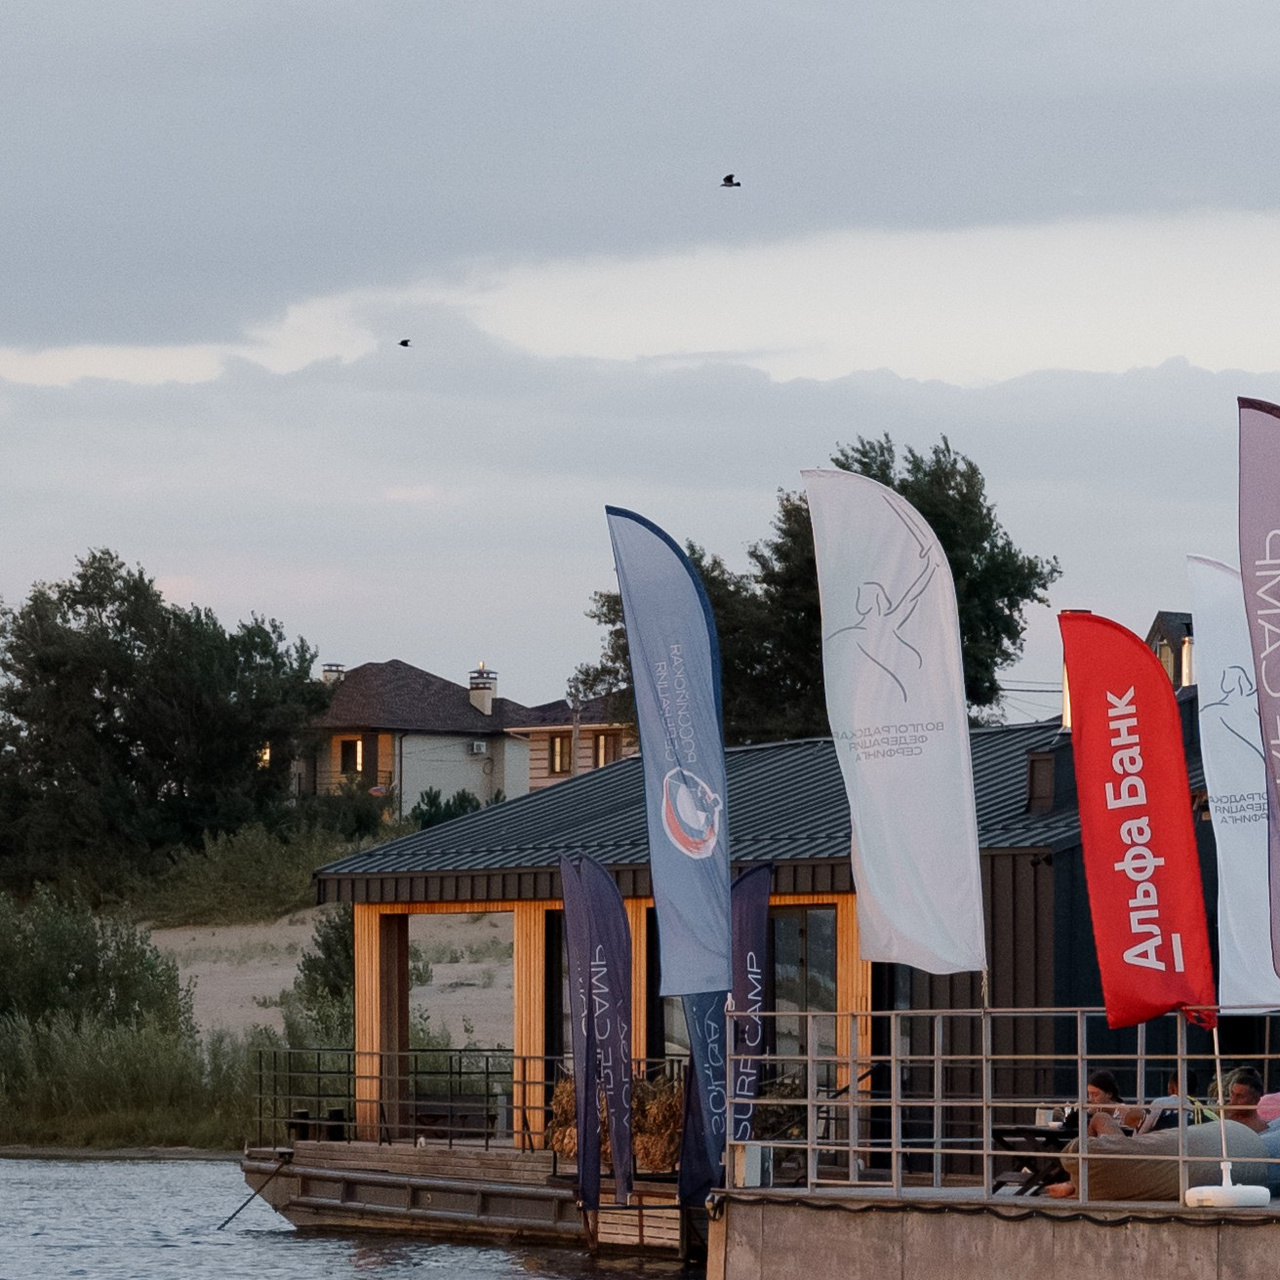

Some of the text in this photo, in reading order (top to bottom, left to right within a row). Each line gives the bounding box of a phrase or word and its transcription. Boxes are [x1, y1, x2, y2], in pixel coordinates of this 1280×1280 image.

[1104, 685, 1166, 972] Альфа Банк
[744, 952, 762, 1047] CAMP
